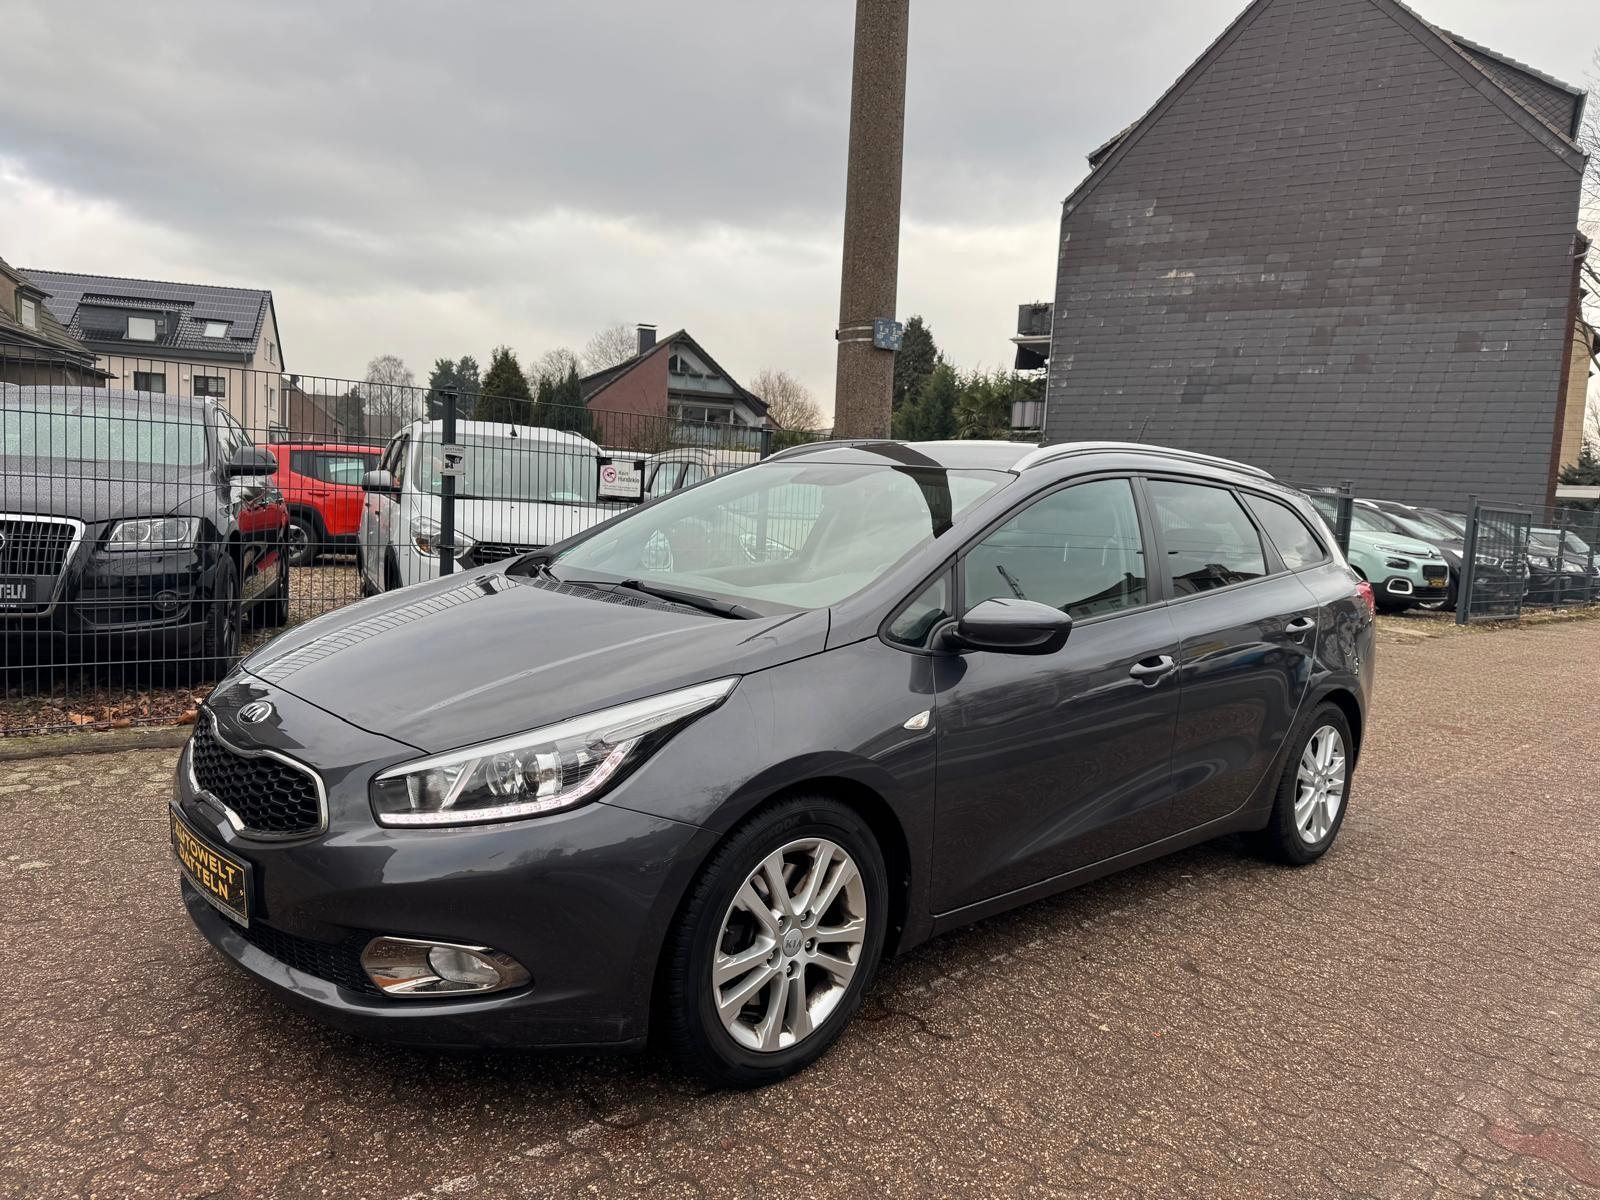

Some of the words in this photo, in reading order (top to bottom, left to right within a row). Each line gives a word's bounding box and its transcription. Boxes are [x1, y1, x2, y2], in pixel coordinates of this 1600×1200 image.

[175, 820, 236, 885] AUTOWELT
[179, 844, 229, 901] DATTELN
[785, 938, 802, 949] KIA
